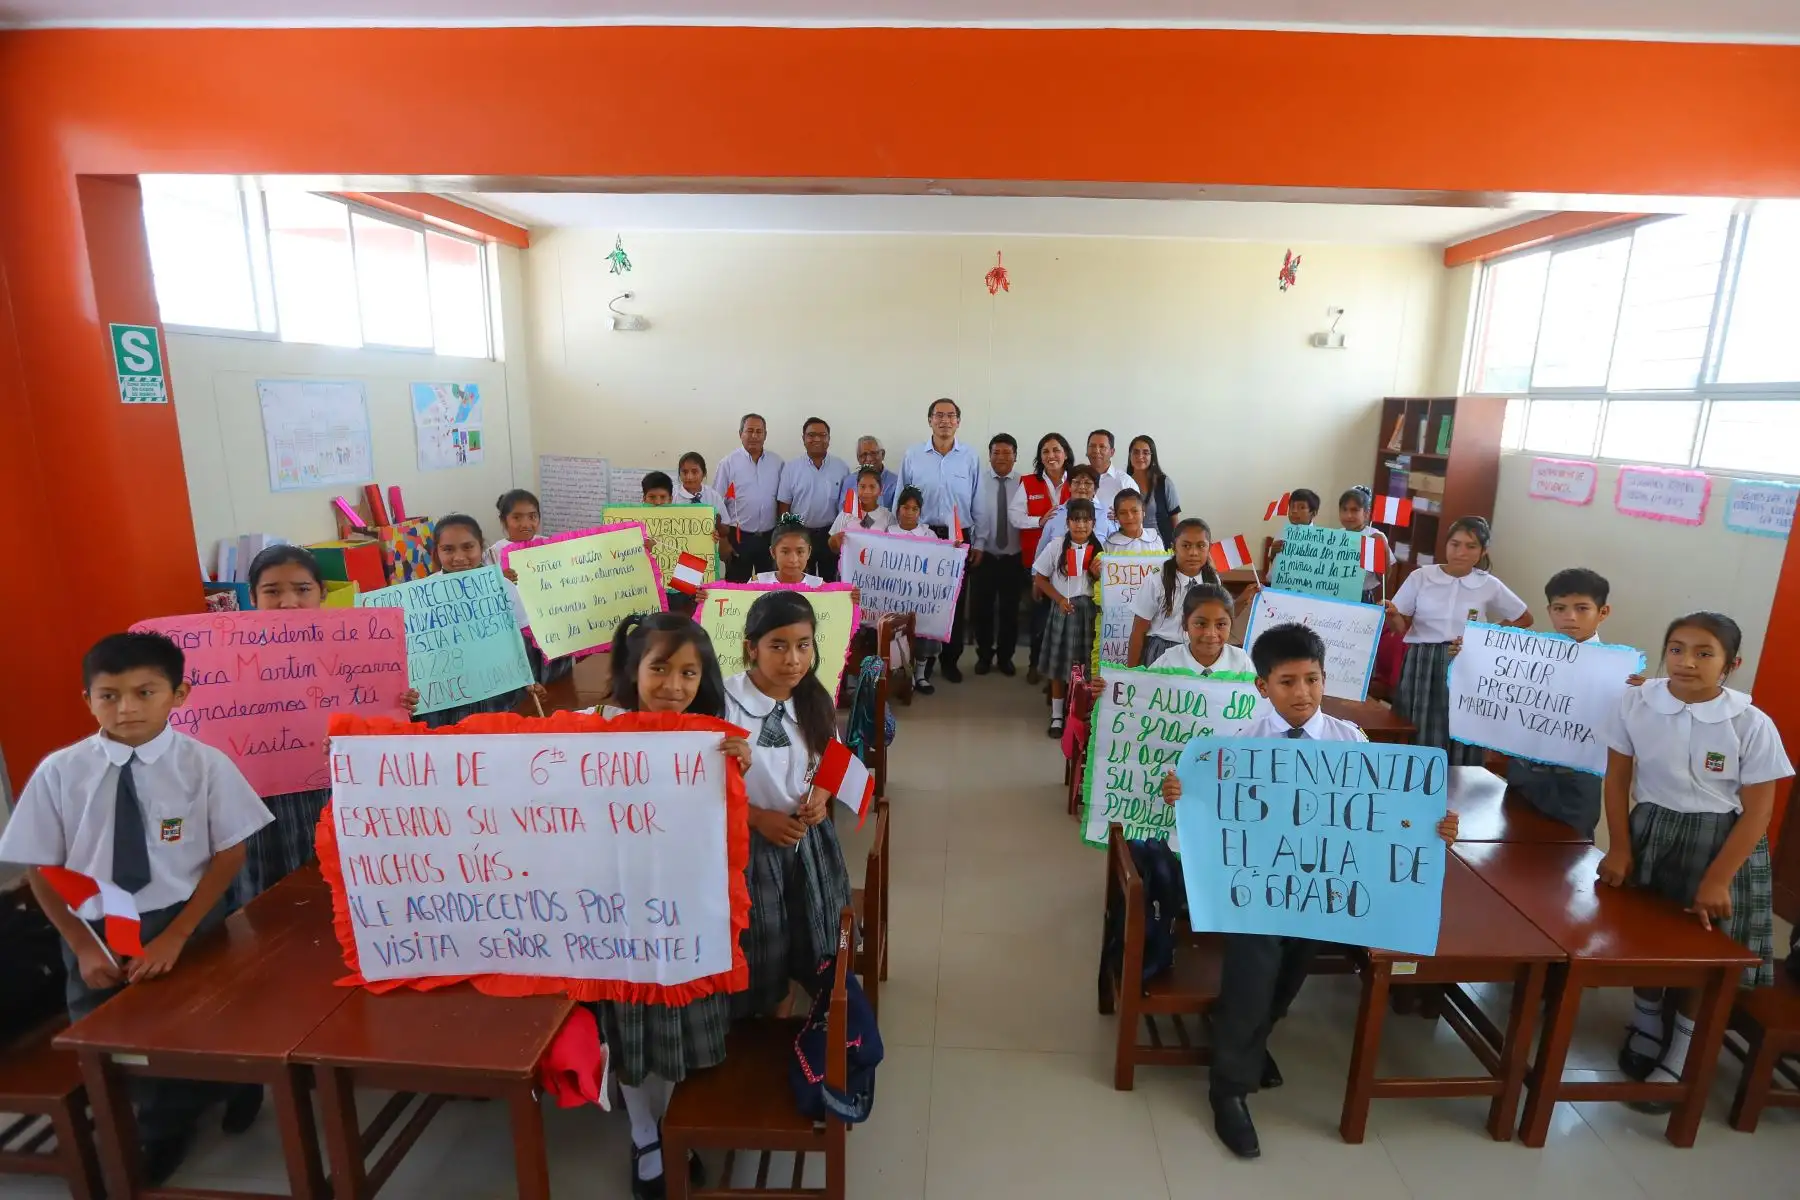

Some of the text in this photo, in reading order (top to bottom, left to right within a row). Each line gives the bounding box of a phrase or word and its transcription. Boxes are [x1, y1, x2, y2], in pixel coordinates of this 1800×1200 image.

[121, 330, 154, 372] S
[213, 615, 324, 647] Presidente
[332, 621, 360, 641] de
[368, 616, 395, 640] la
[454, 627, 465, 644] A
[1484, 629, 1580, 664] BIENVENIDO
[236, 653, 317, 682] Martin
[1494, 655, 1555, 685] SEÑOR
[1112, 681, 1136, 708] El
[1476, 675, 1576, 716] PRESIDENTE
[168, 698, 308, 734] agradecemos
[1518, 708, 1596, 745] VIZCARRA
[333, 751, 358, 786] EL
[378, 751, 439, 787] AULA
[456, 751, 489, 787] DE
[580, 751, 650, 787] GRADO
[674, 751, 707, 786] HA
[1217, 747, 1445, 796] BIENVENIDO
[340, 801, 666, 839] ESPERADO SU VISITA POR
[1217, 783, 1269, 822] LES
[1292, 788, 1387, 833] DICE
[347, 853, 446, 887] MUCHOS
[1221, 827, 1430, 885] EL AULA DE
[405, 888, 569, 923] AGRADECEMOS
[578, 888, 629, 926] POR
[646, 898, 681, 926] SU
[1265, 873, 1371, 918] GRADO
[372, 933, 459, 967] VISITA
[478, 926, 549, 960] SEÑOR
